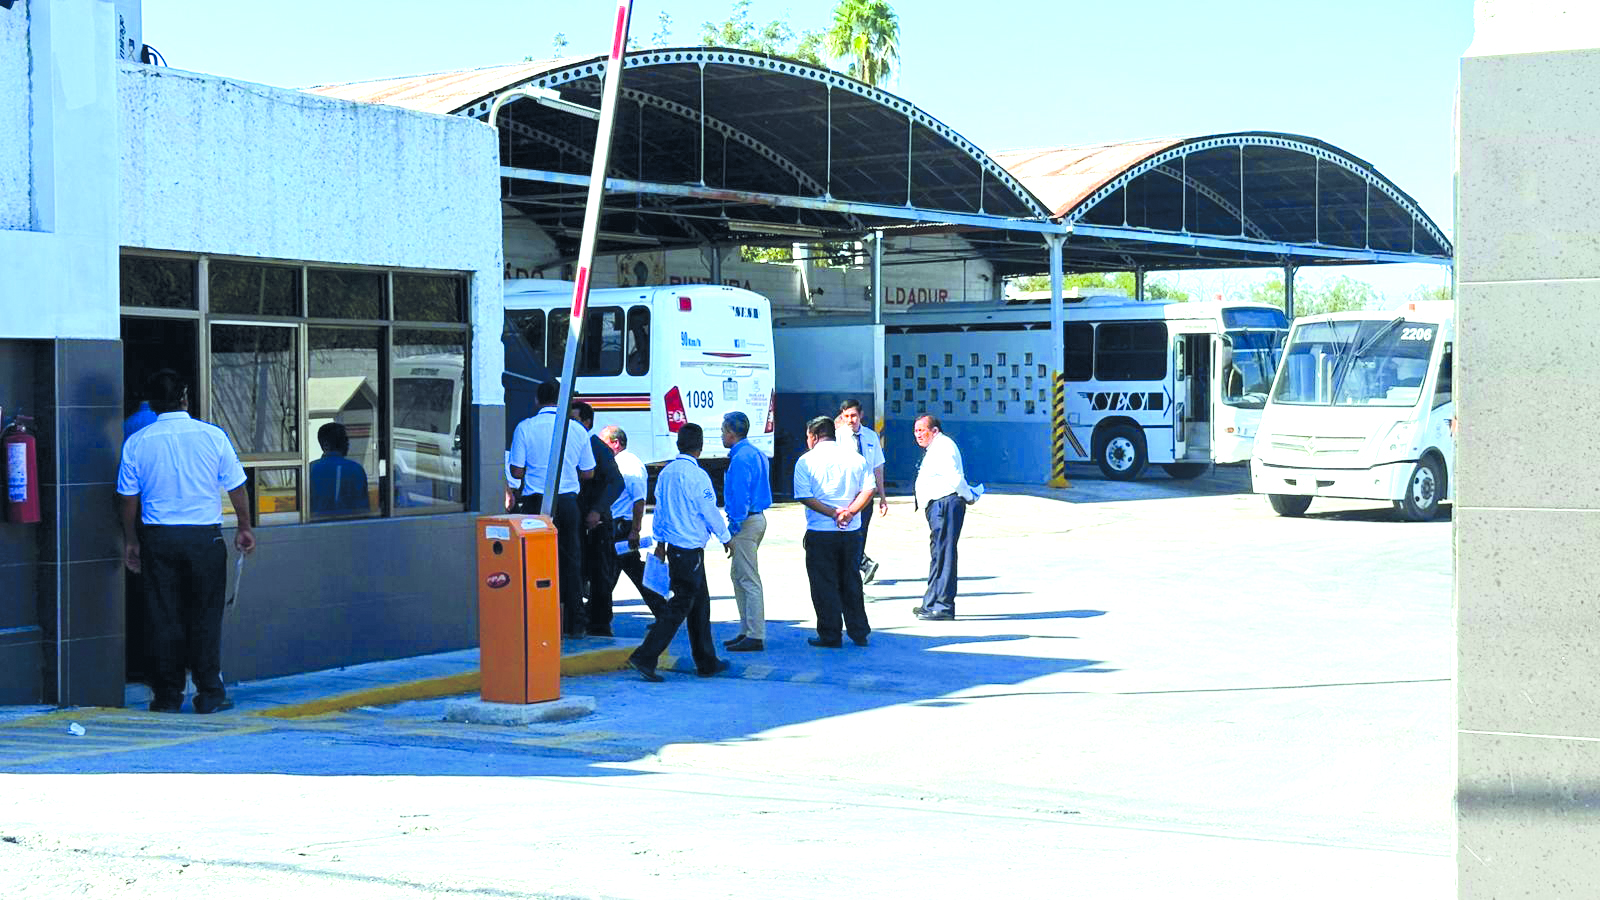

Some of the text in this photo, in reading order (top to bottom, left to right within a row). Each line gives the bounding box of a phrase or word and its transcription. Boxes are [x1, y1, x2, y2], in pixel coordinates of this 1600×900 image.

[669, 276, 752, 290] PINTRA
[1401, 327, 1432, 341] 2206
[686, 390, 714, 408] 1098
